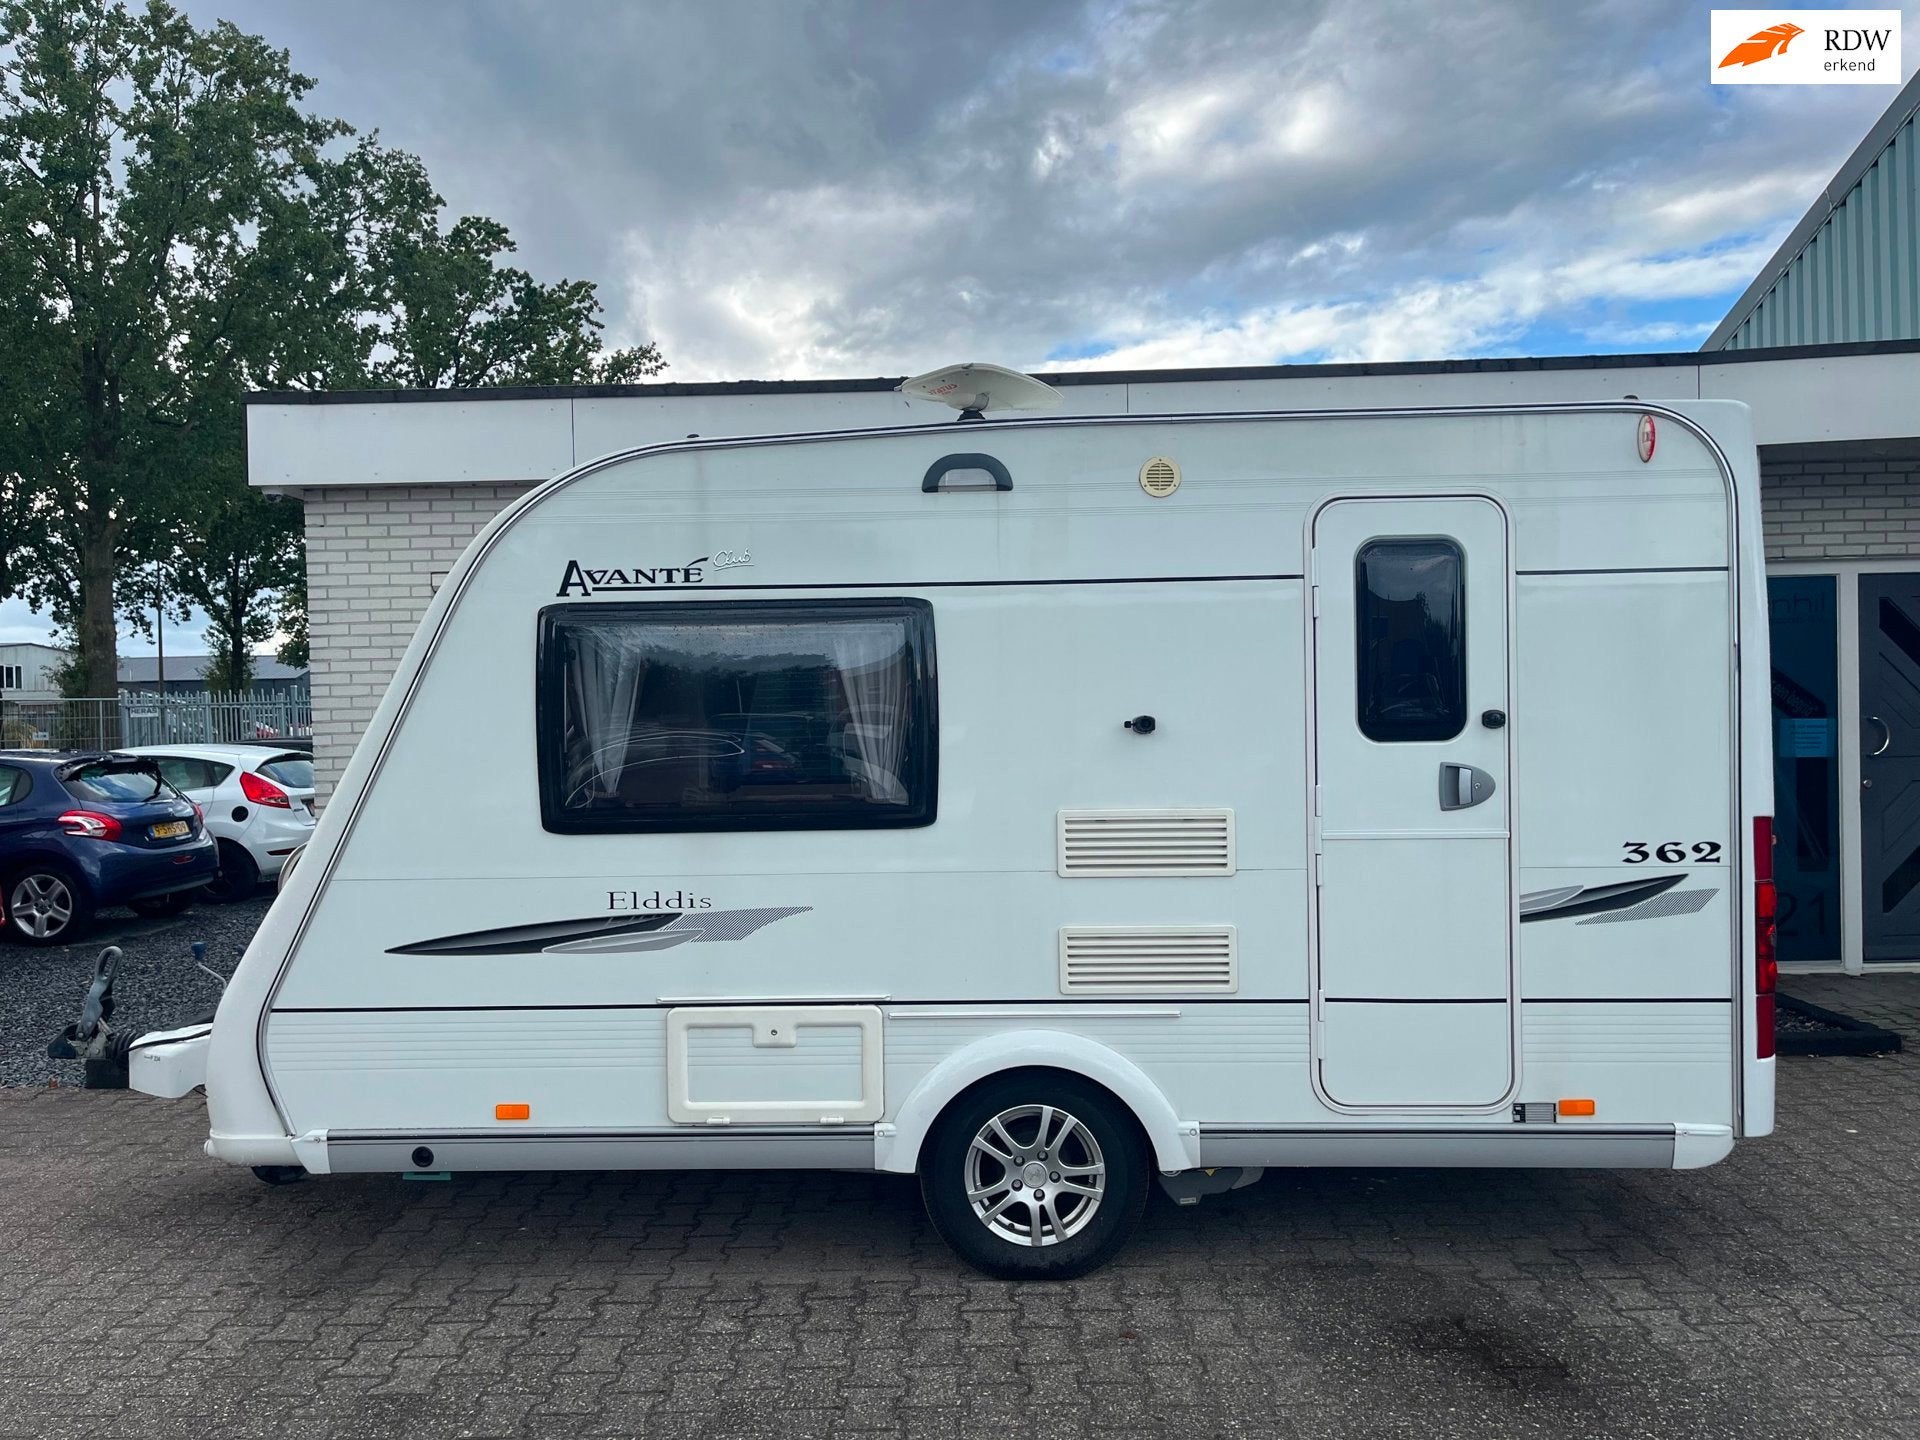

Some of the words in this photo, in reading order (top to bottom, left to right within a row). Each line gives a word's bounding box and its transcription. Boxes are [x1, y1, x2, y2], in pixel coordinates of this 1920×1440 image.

[131, 706, 158, 714] HERAS
[1622, 841, 1722, 864] 362
[606, 890, 712, 910] Elddis
